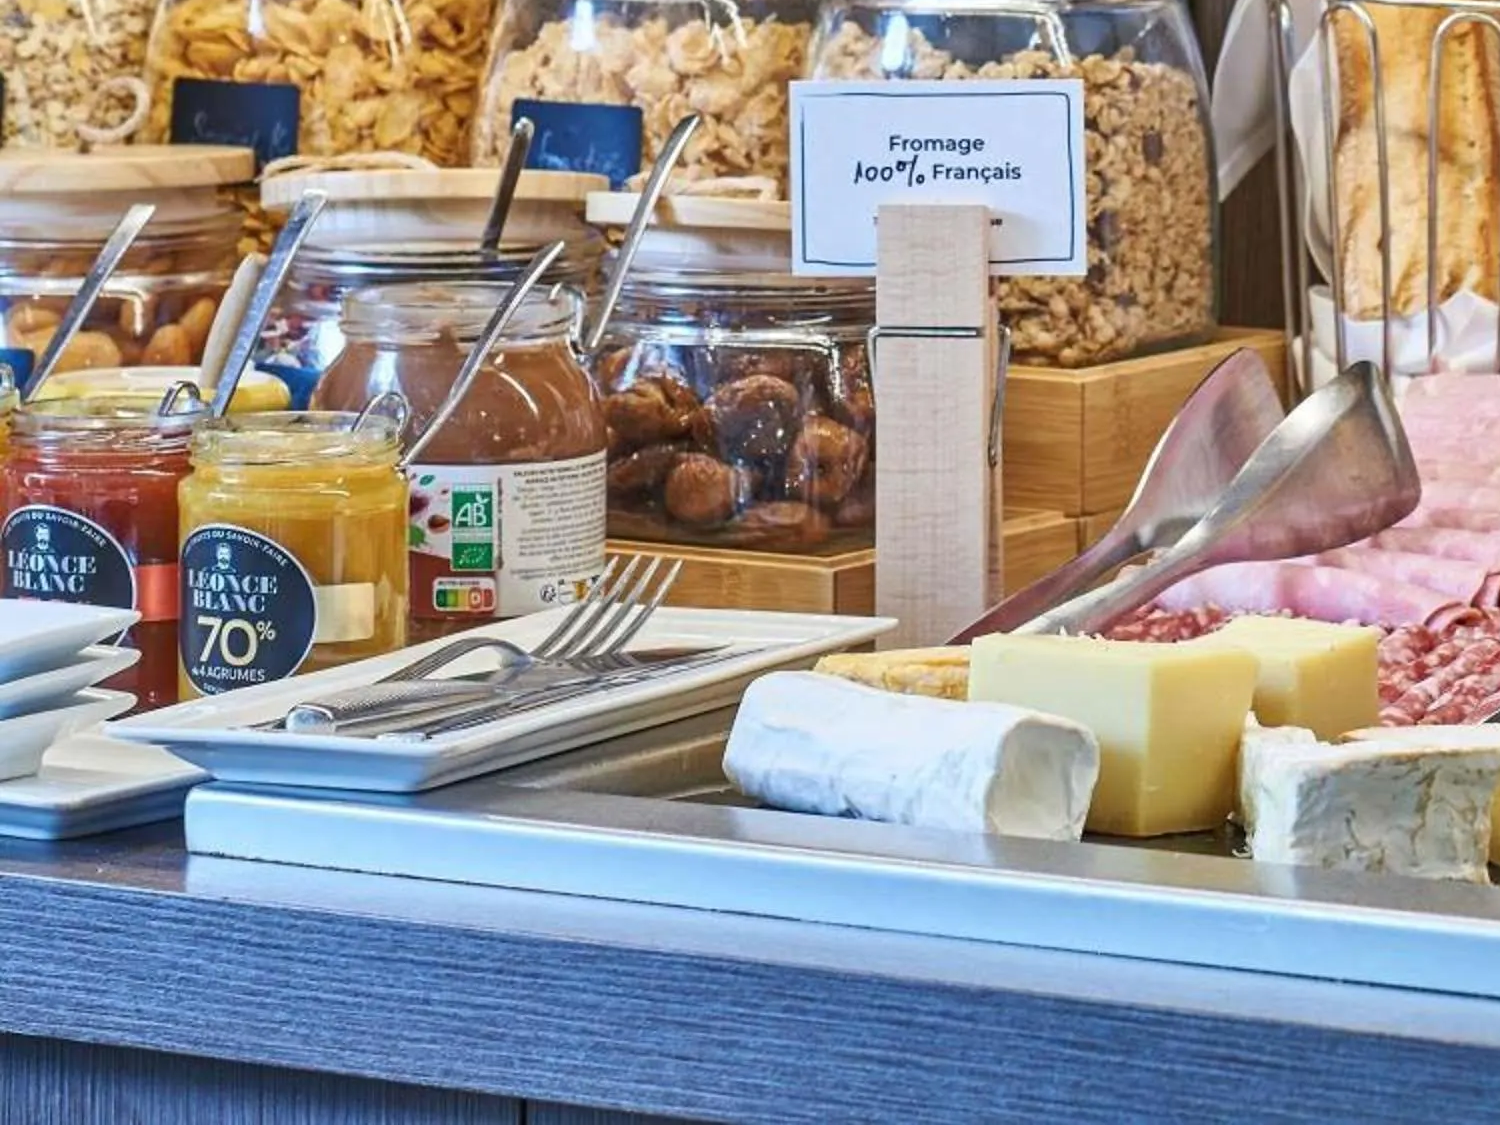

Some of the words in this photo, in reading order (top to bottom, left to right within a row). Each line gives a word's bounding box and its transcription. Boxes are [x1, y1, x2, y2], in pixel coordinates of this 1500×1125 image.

[888, 135, 986, 156] Fromage
[853, 155, 926, 187] 100%
[932, 162, 1023, 185] Français
[454, 501, 487, 527] AB
[211, 530, 225, 538] DU
[8, 548, 97, 575] LÉONCE
[12, 570, 84, 594] BLANC
[187, 567, 278, 596] LÉONCE
[192, 589, 265, 614] BLANC
